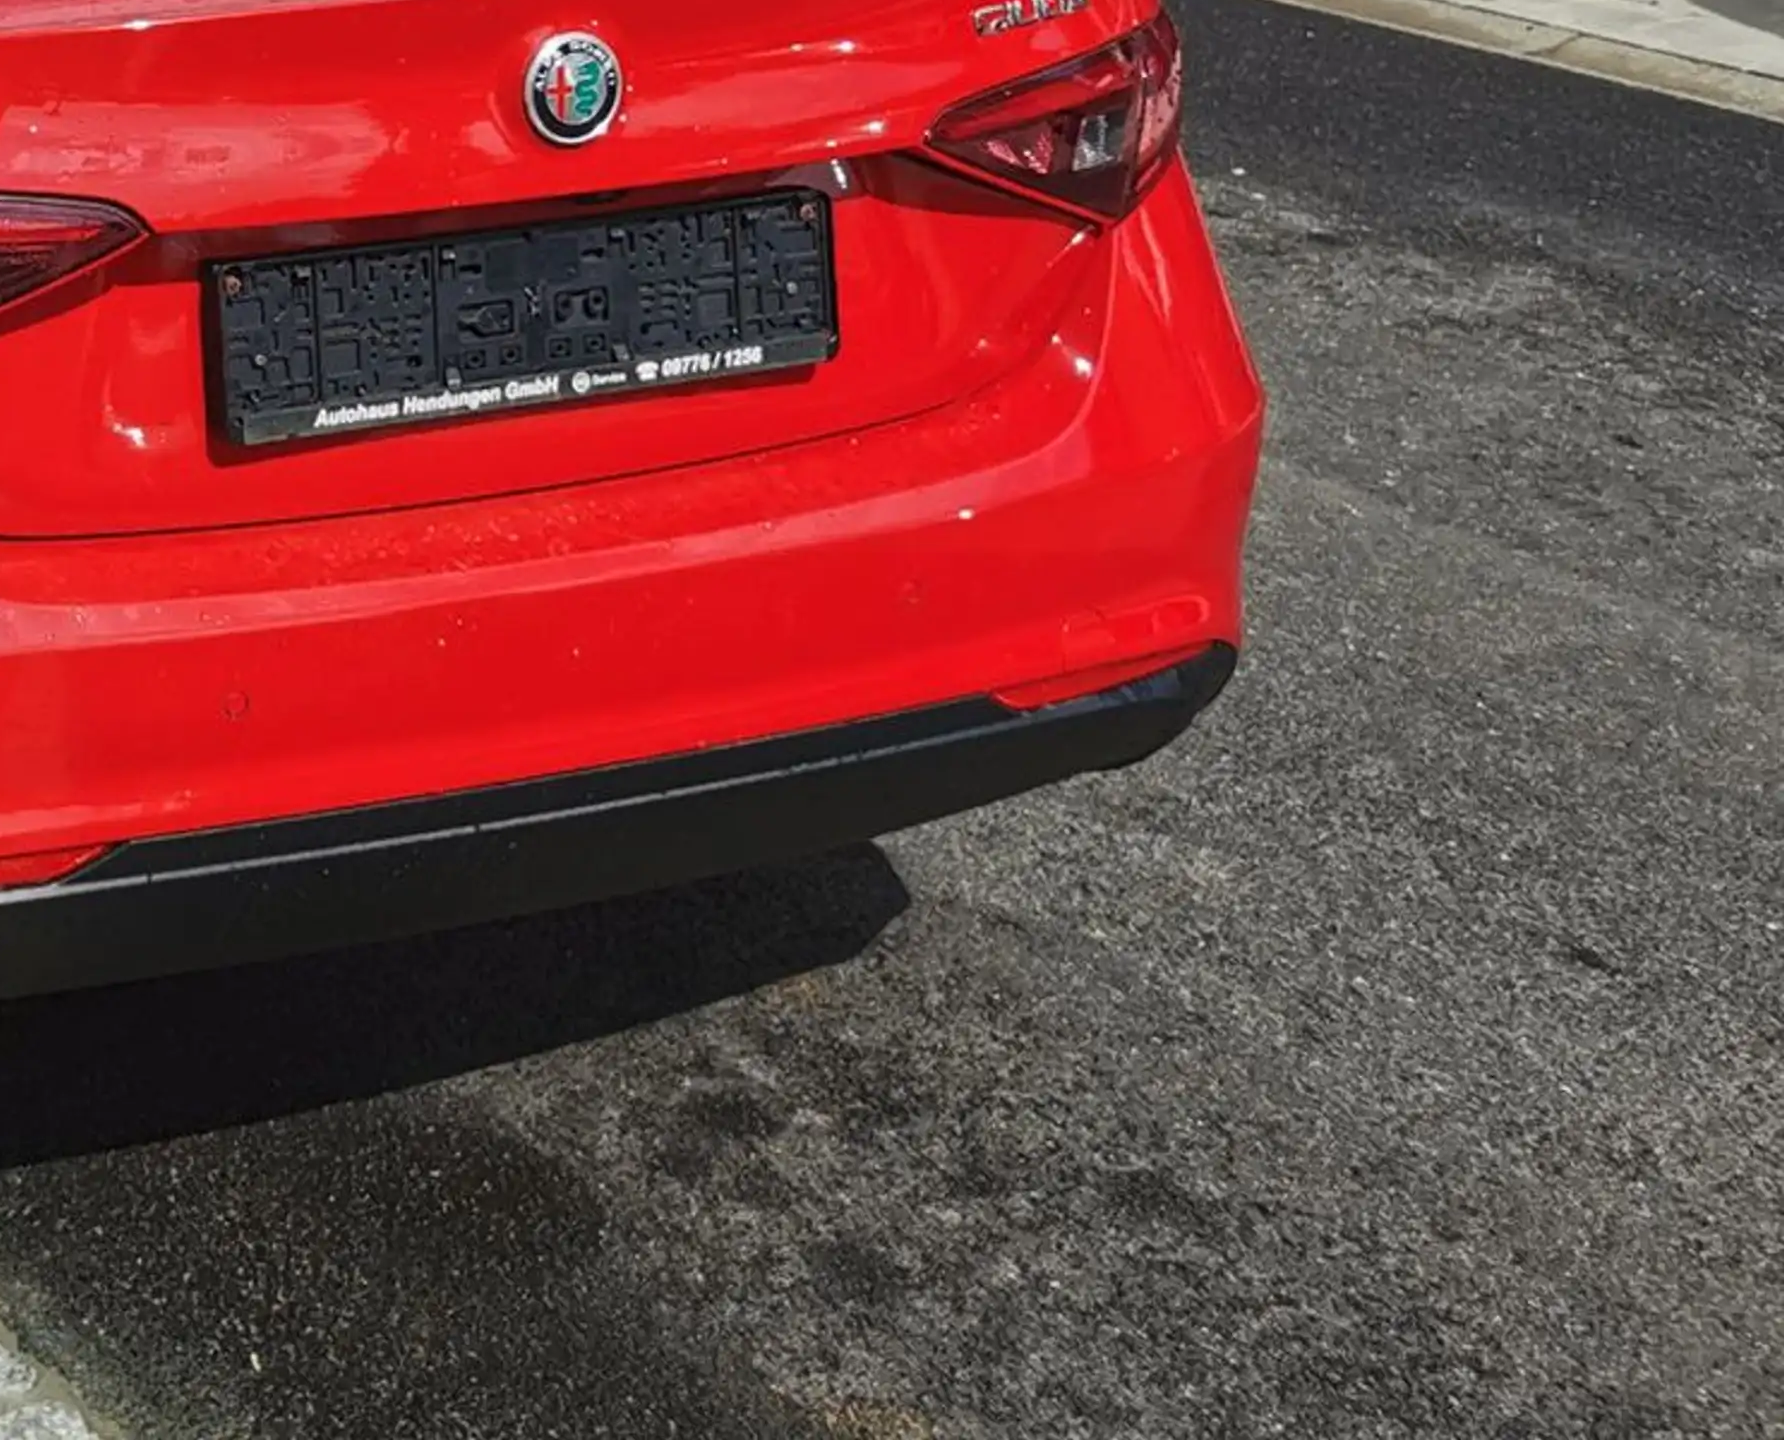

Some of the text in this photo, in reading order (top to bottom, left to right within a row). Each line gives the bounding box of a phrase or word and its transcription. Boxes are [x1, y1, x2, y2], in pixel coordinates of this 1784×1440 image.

[313, 373, 560, 429] Autohaus Hendungen GmbH
